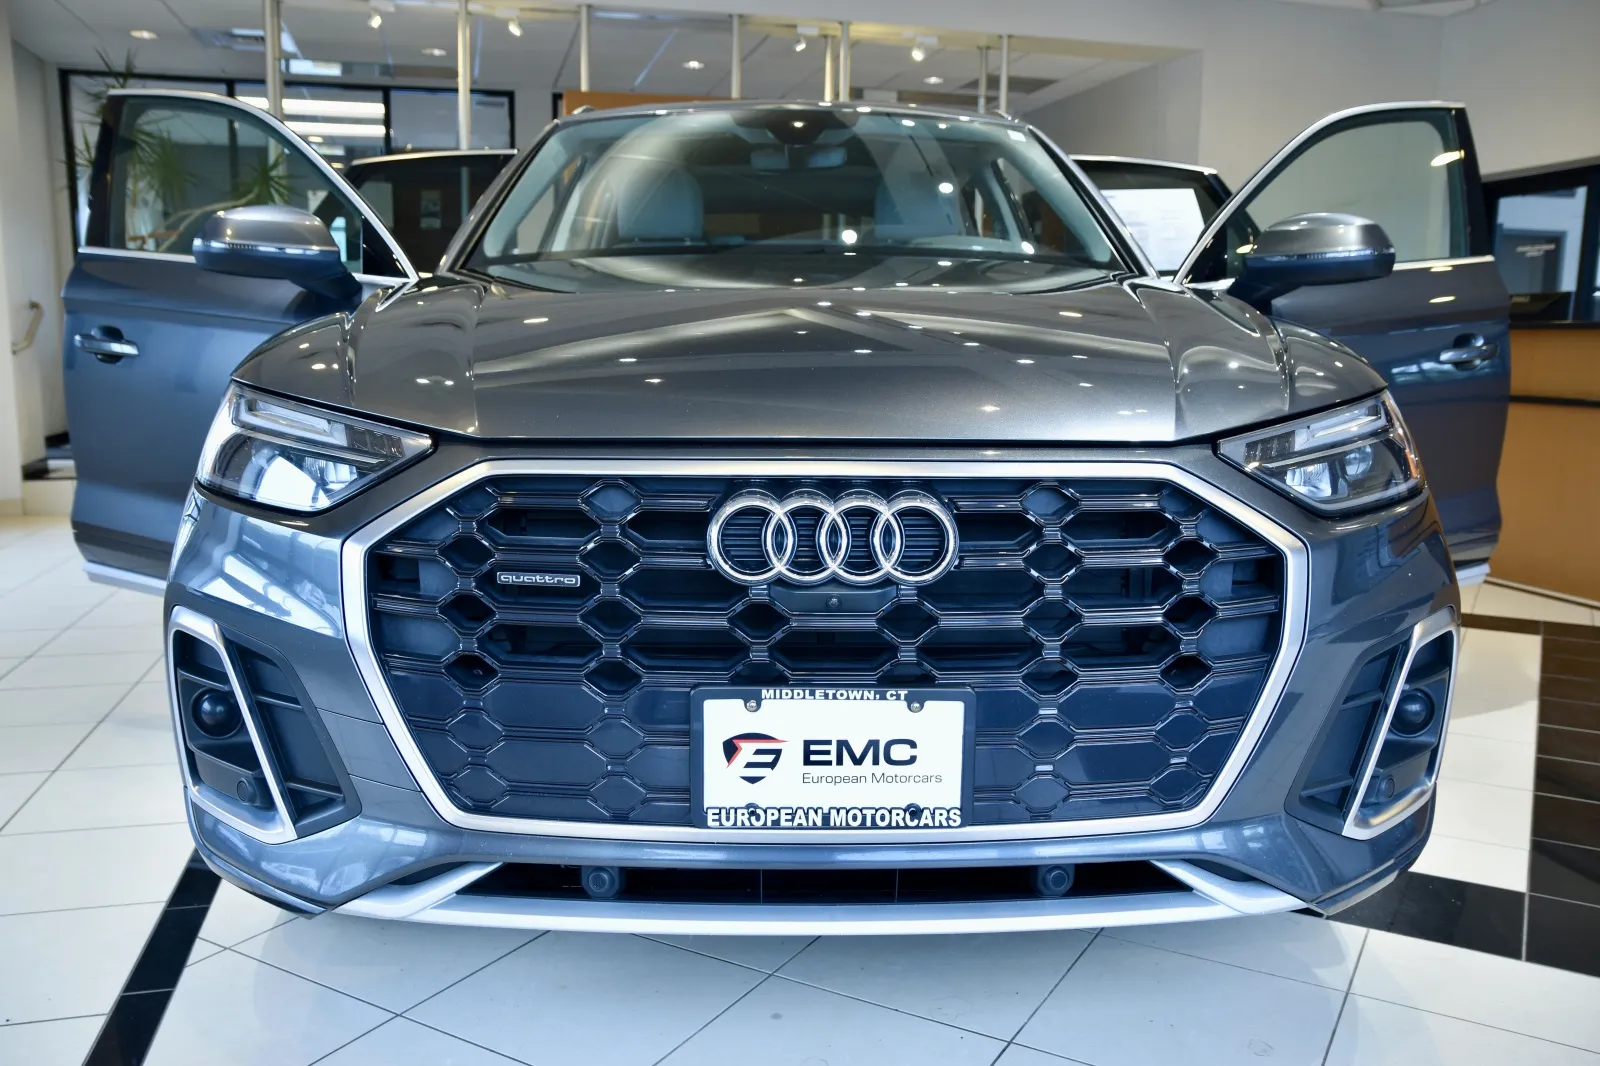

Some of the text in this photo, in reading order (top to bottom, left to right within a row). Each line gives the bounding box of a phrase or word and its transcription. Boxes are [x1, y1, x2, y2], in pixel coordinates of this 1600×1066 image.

[500, 574, 576, 584] quattro
[761, 689, 908, 700] MIDDLETOWN, CT
[802, 738, 918, 767] EMC
[802, 772, 943, 785] European Motorcars
[707, 808, 962, 827] EUROPEAN MOTORCARS
